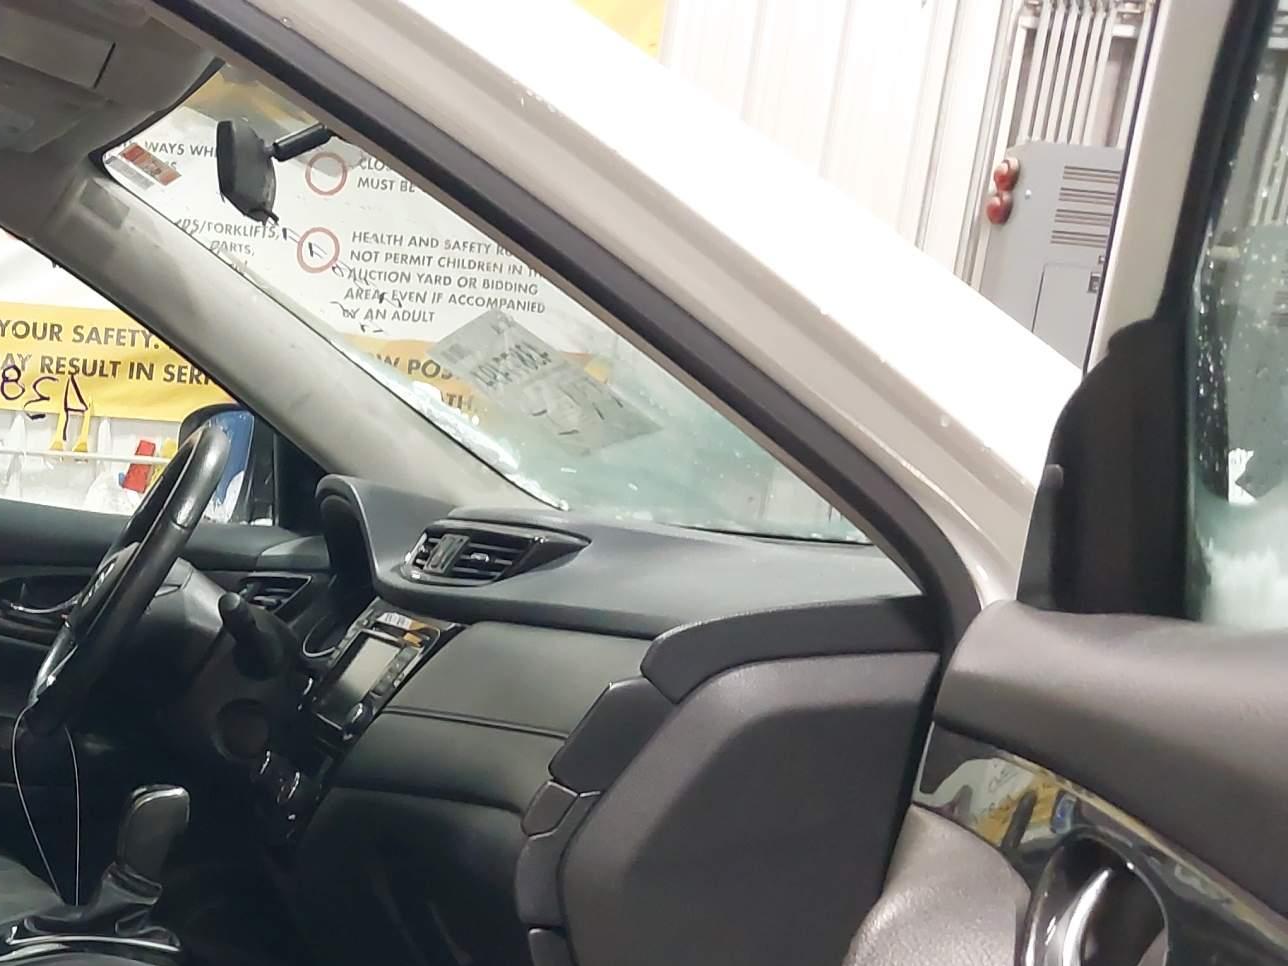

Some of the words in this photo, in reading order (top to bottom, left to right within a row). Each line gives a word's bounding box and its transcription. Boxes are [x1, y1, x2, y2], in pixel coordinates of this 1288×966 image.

[189, 144, 217, 159] WH
[357, 177, 395, 191] MUST
[352, 231, 404, 247] HEALTH
[407, 235, 439, 250] AND
[444, 239, 492, 255] SAFETY
[350, 250, 381, 263] NOT
[384, 252, 433, 267] PERMIT
[437, 256, 504, 274] CHILDREN
[508, 263, 524, 275] IN
[347, 268, 412, 284] AUCTION
[416, 273, 452, 287] YARD
[457, 276, 477, 289] OR
[482, 279, 539, 296] BIDDING
[391, 289, 428, 302] EVEN
[431, 292, 444, 304] IF
[448, 294, 546, 314] ACCOMPANIED
[363, 308, 388, 321] AN
[391, 309, 436, 323] ADULT
[40, 355, 122, 379] RESULT
[128, 361, 154, 381] IN
